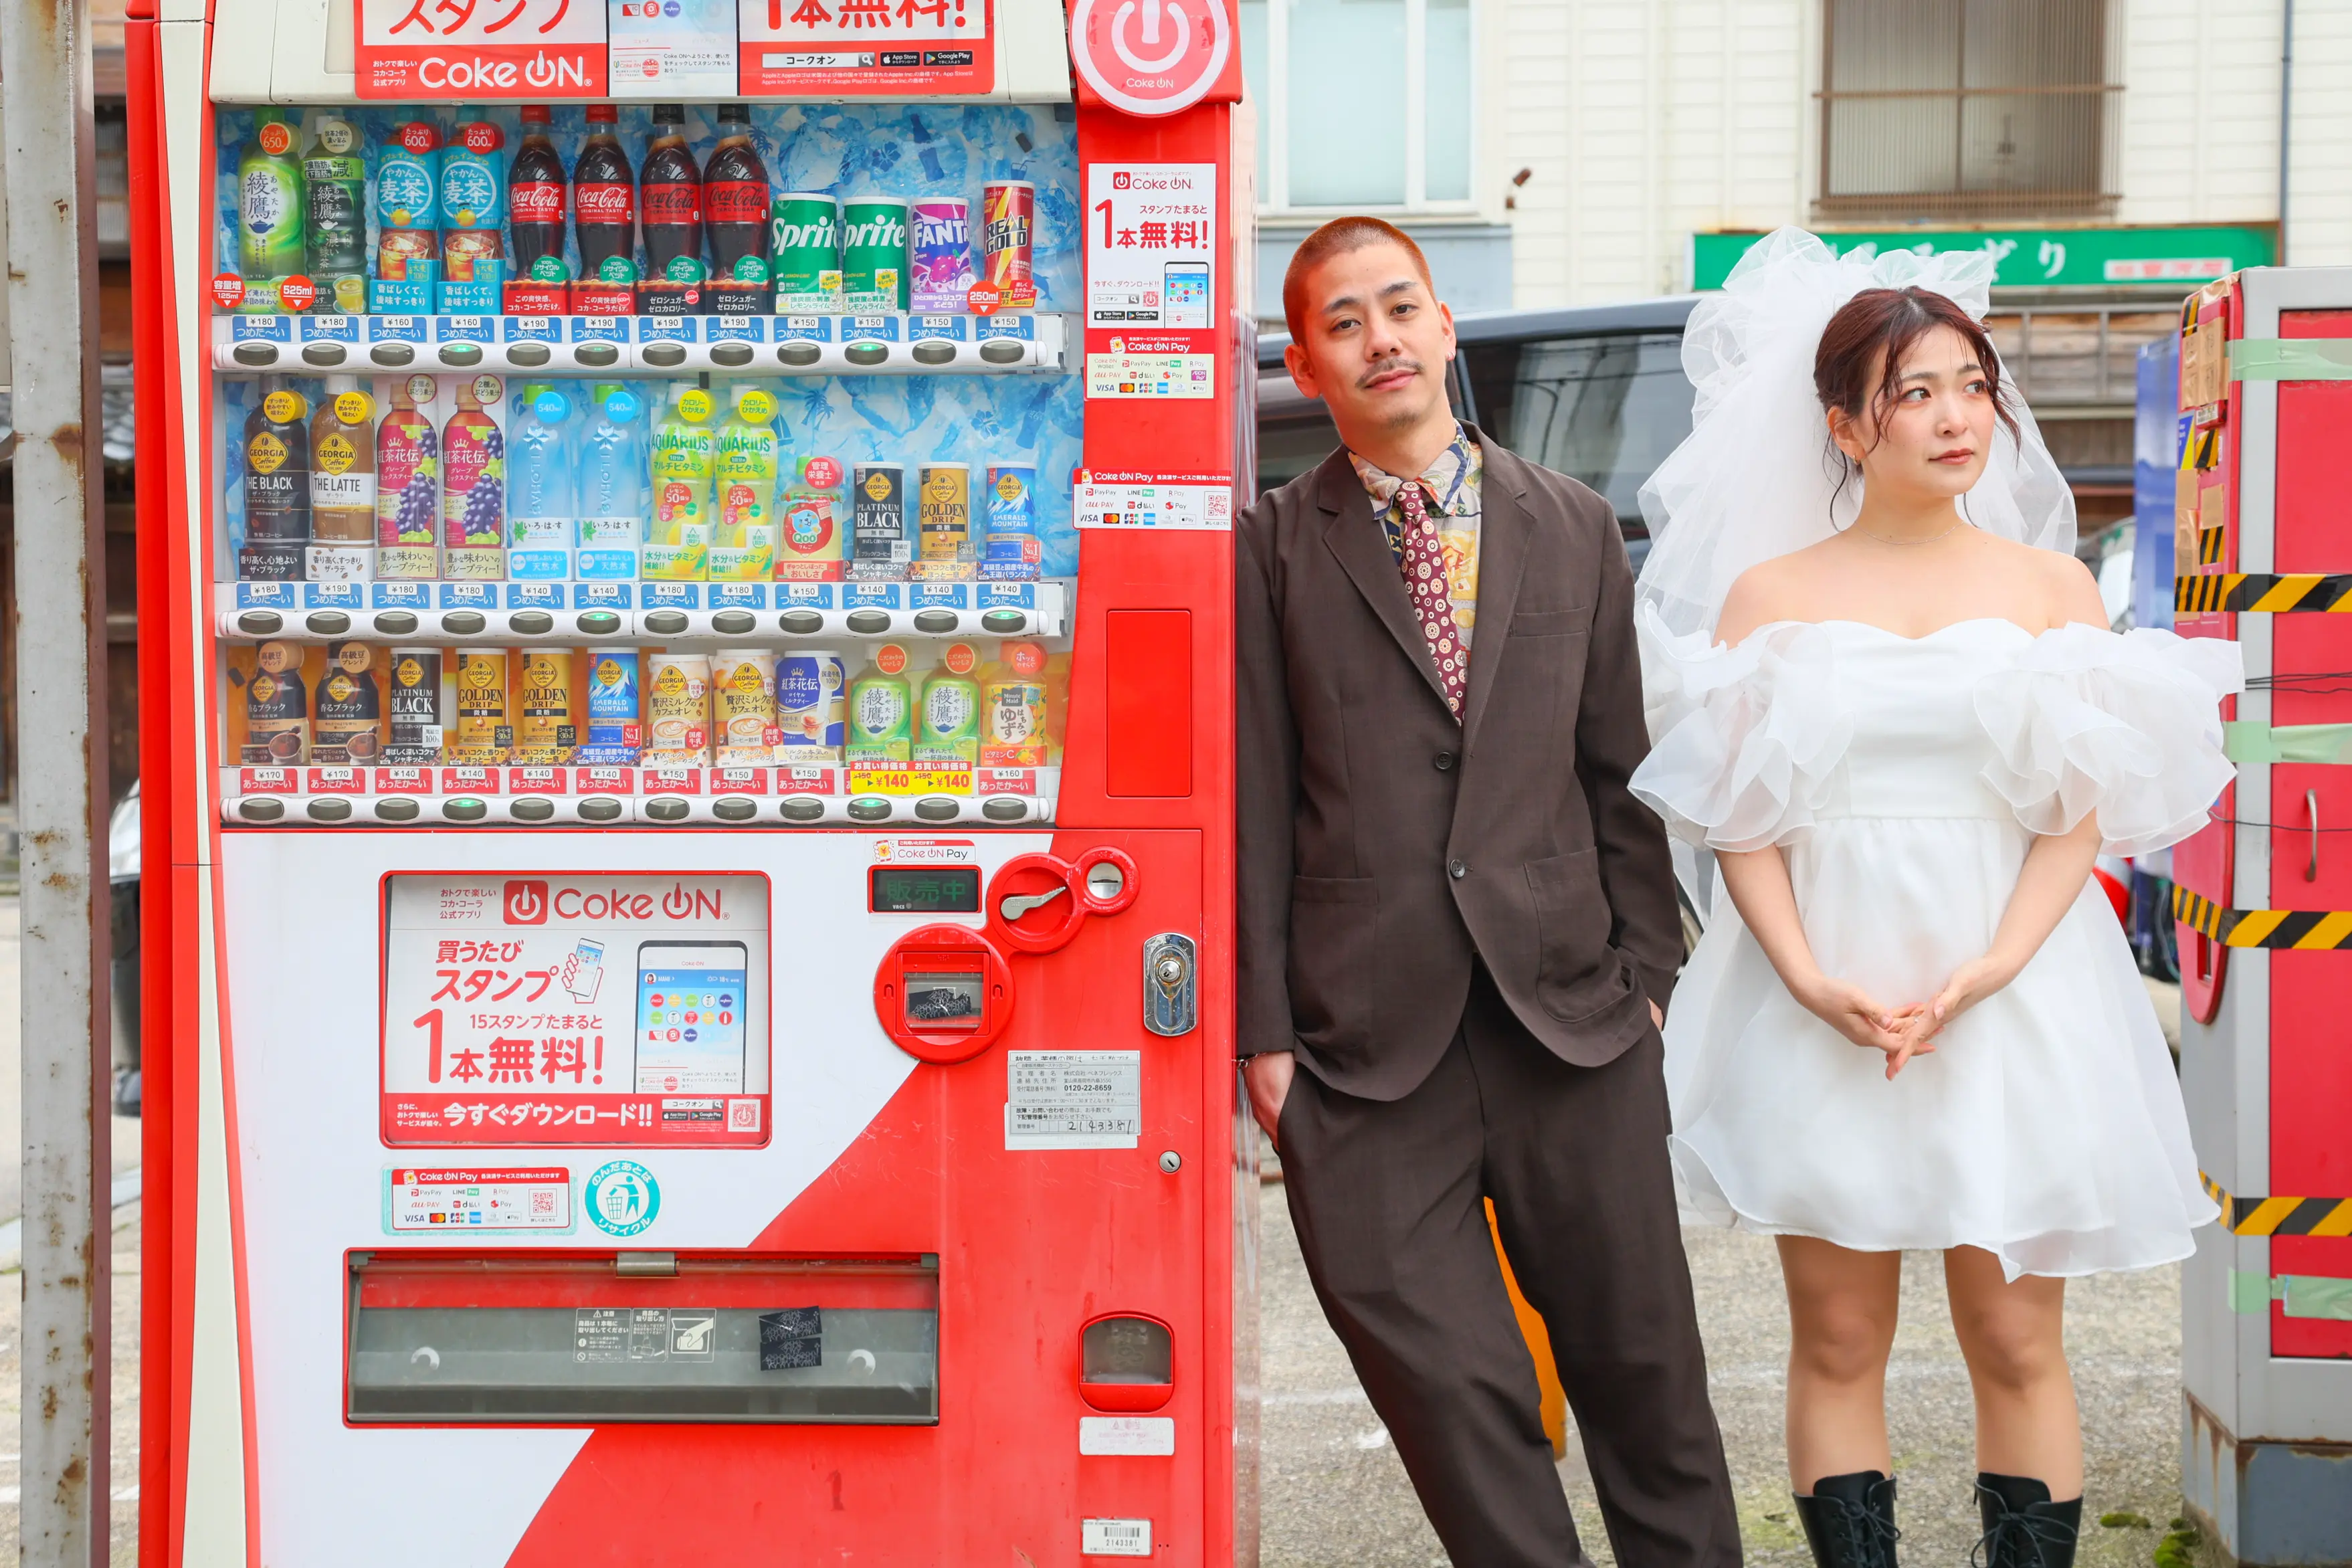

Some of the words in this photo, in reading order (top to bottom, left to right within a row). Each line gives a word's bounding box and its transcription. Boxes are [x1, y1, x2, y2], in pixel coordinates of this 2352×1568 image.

[786, 56, 836, 65] コークオン
[418, 56, 517, 88] Coke
[1126, 77, 1155, 88] Coke
[1133, 179, 1167, 190] Coke
[380, 182, 427, 204] 麦茶
[444, 182, 490, 204] 麦茶
[1140, 205, 1207, 214] スタンプたまると
[986, 215, 1025, 241] REAL
[844, 215, 904, 256] prite
[986, 231, 1027, 256] GOLD
[283, 285, 312, 296] 525ml
[970, 292, 999, 300] 250ml
[718, 295, 757, 303] ゼロシュガー
[1129, 342, 1154, 351] Coke
[1171, 342, 1190, 353] Pay
[682, 399, 706, 407] カロリー
[652, 436, 708, 451] AQUARIUS
[714, 437, 771, 452] AQUARIUS
[249, 449, 285, 458] GEORGIA
[318, 450, 355, 459] GEORGIA
[654, 462, 704, 472] マルチビタミン
[716, 464, 765, 473] マルチビタミン
[811, 462, 828, 470] 管理
[1095, 472, 1118, 480] Coke
[1135, 473, 1153, 482] Pay
[260, 477, 293, 490] BLACK
[314, 478, 329, 491] THE
[330, 478, 361, 492] LATTE
[857, 504, 899, 512] PLATINUM
[922, 503, 965, 518] GOLDEN
[857, 512, 900, 528] BLACK
[793, 533, 816, 544] Qoo
[791, 570, 819, 579] おいしさ
[781, 678, 818, 691] 紅茶花伝
[391, 689, 433, 697] PLATINUM
[459, 688, 502, 702] GOLDEN
[524, 688, 567, 702] GOLDEN
[391, 698, 433, 713] BLACK
[655, 706, 691, 716] カフェオレ
[730, 704, 767, 714] カフェオレ
[866, 688, 884, 724] 綾鷹
[936, 687, 954, 724] 綾鷹
[854, 761, 908, 771] お買い得価格
[914, 761, 969, 771] お買い得価格
[898, 849, 926, 858] Coke
[947, 849, 968, 860] Pay
[440, 888, 496, 897] おトクで楽しい
[886, 878, 967, 902] 販売中
[554, 888, 654, 920] Coke
[439, 910, 482, 919] 公式アプリ
[435, 939, 524, 963] 買うたび
[431, 965, 559, 1002] スタンプ
[470, 1013, 603, 1030] 15スタンプたまると
[419, 1173, 443, 1181] Coke
[460, 1173, 478, 1183] Pay
[591, 1161, 653, 1186] のんだあとは
[597, 1216, 652, 1236] リサイクル
